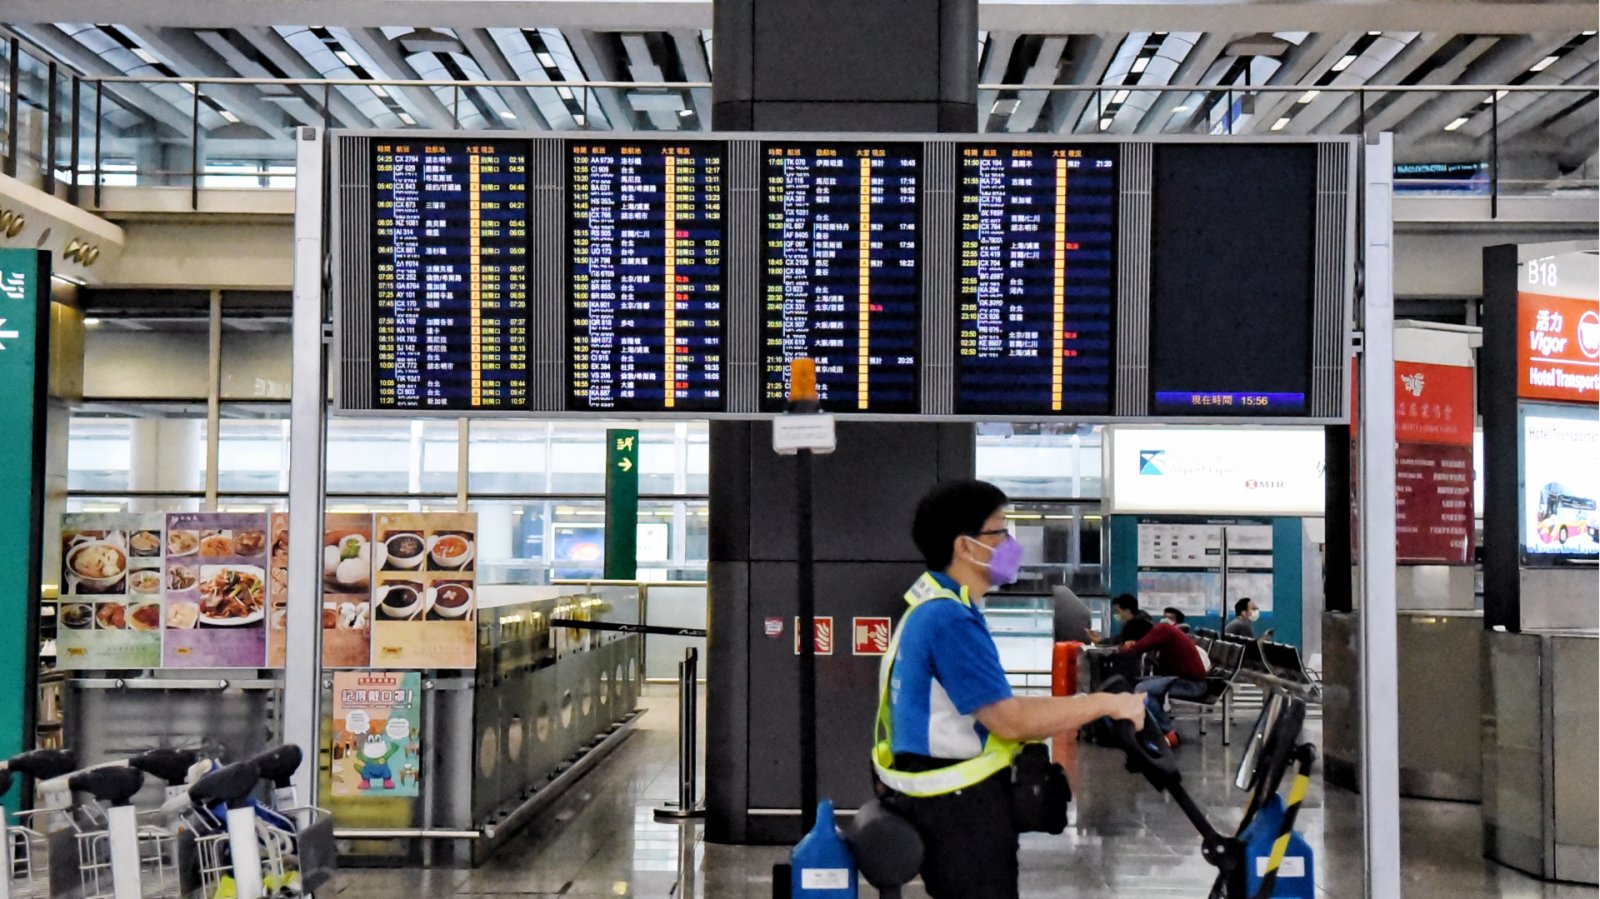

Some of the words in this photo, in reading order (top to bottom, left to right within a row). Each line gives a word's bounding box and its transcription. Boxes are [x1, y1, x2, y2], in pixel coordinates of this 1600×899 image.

[1528, 260, 1557, 287] B18
[1536, 310, 1563, 333] 活力
[1530, 330, 1568, 356] Vigor
[1529, 366, 1555, 388] Hotel
[1191, 394, 1233, 406] 現在時間
[1241, 396, 1269, 406] 15:56
